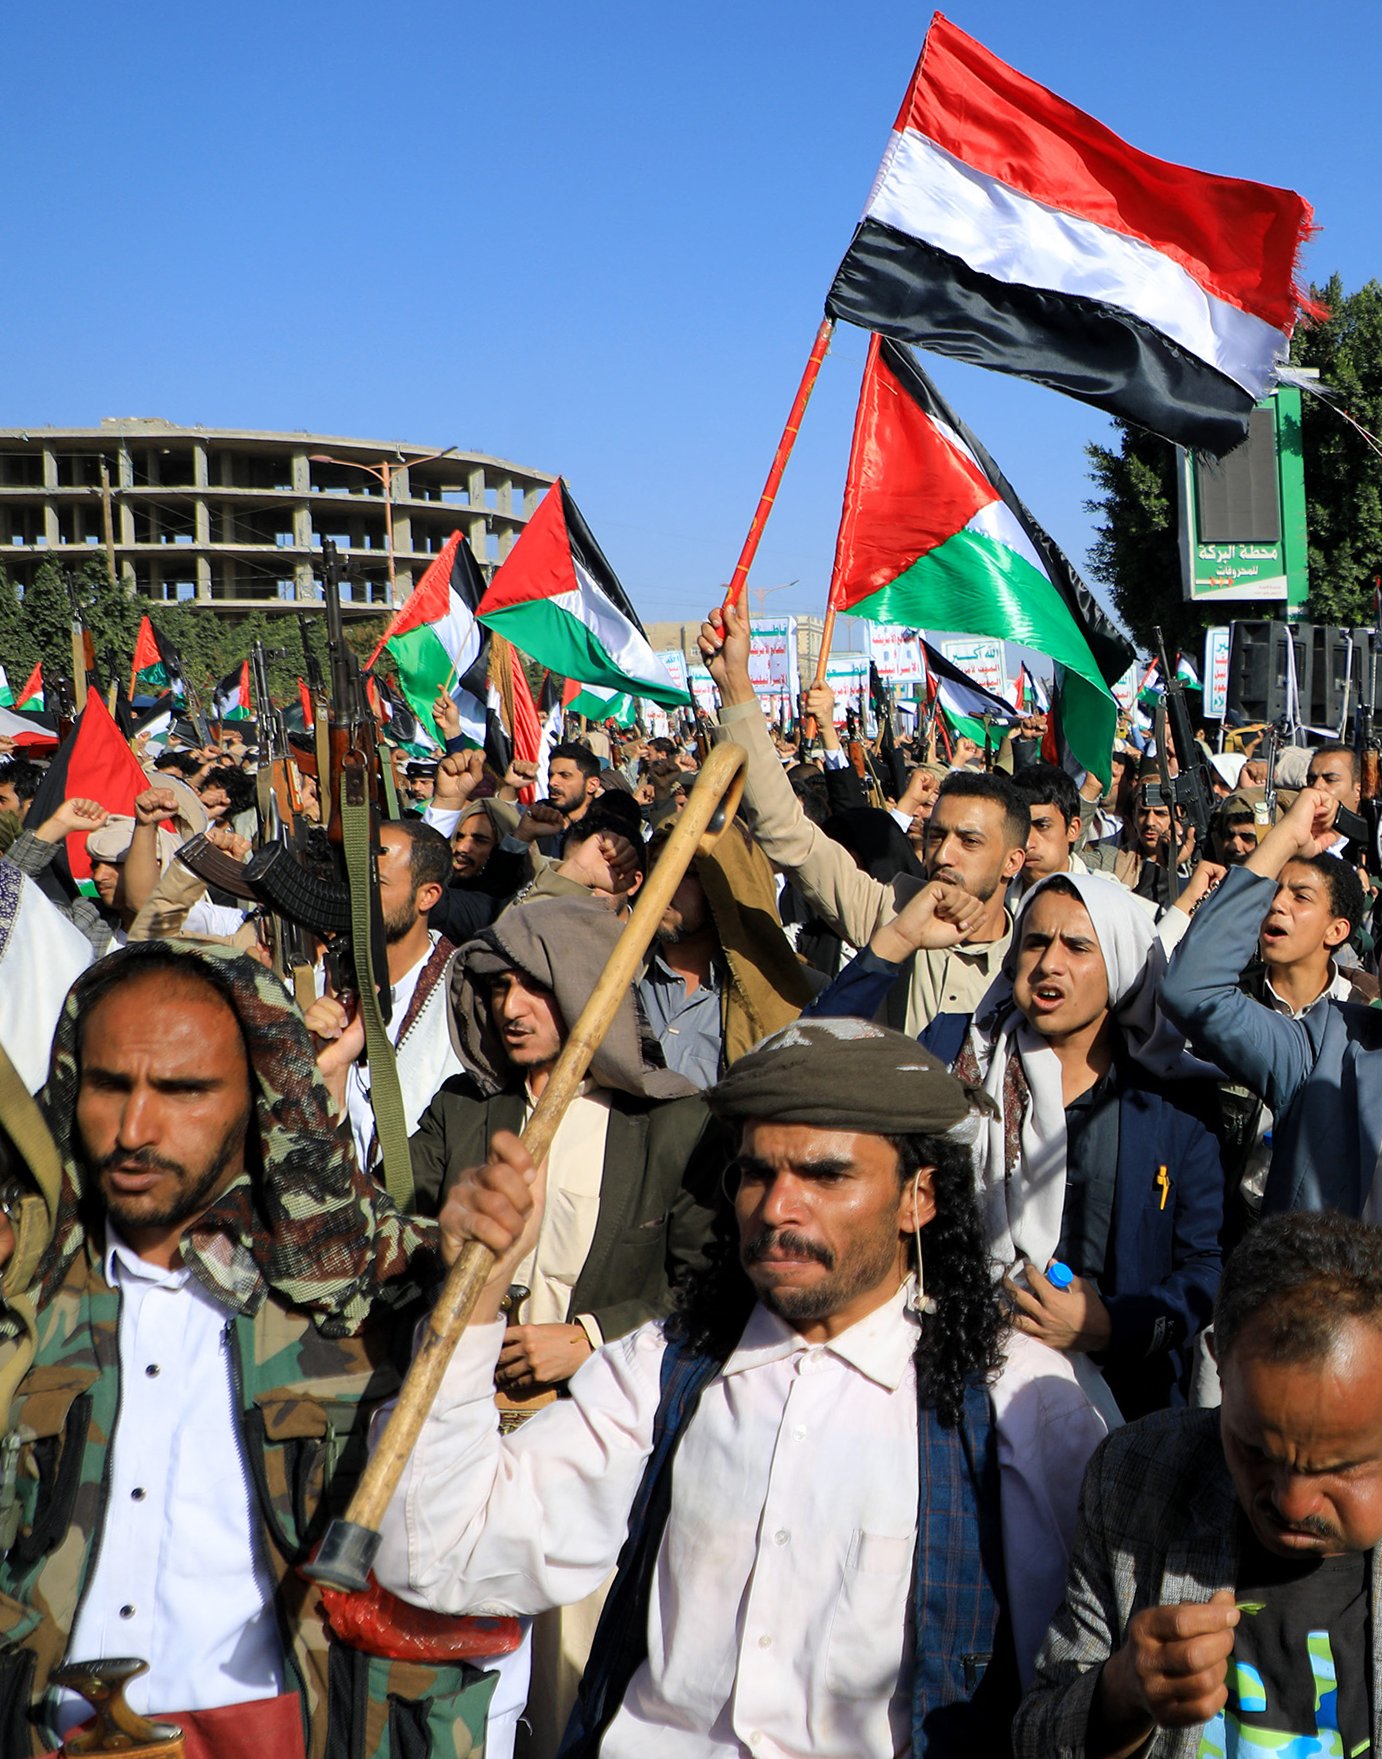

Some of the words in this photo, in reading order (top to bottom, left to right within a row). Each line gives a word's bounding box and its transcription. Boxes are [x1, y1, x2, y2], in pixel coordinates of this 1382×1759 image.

[1198, 543, 1236, 564] البركة
[1240, 543, 1278, 560] محطة
[1216, 564, 1259, 579] للمحروقات
[985, 645, 999, 659] الله
